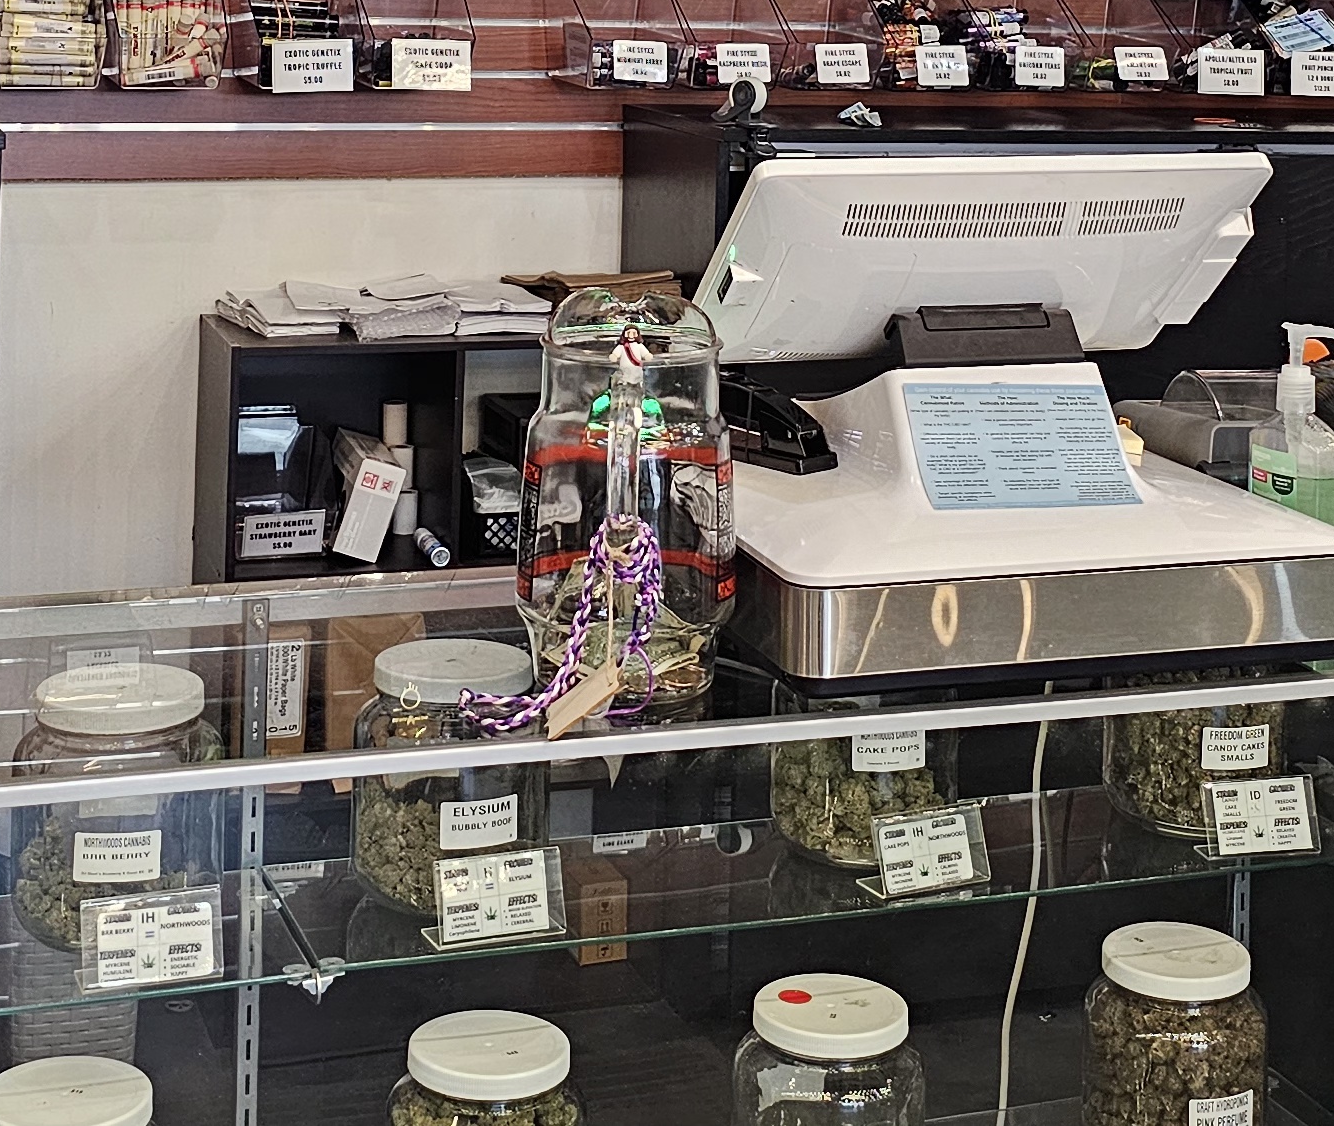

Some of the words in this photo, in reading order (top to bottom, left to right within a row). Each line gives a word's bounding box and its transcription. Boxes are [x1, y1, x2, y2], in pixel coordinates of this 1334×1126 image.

[284, 49, 310, 59] EXOTIC
[311, 48, 342, 58] GENETIX
[283, 62, 310, 72] TROPIC
[311, 61, 343, 71] TRUFFLE
[255, 520, 281, 529] EXOTIC
[282, 519, 313, 527] GENETIX
[249, 530, 297, 540] STRAWBERRY
[1209, 729, 1243, 741] FREEDOM
[1245, 727, 1265, 738] GREEN
[856, 745, 888, 754] CAKE
[891, 743, 921, 753] POPS
[1206, 743, 1238, 752] CANDY
[1240, 741, 1265, 751] CAKES
[1220, 753, 1255, 762] SMALLS
[452, 800, 512, 818] ELYSIUM
[451, 821, 488, 832] BUBBLY
[490, 816, 513, 827] BOOF
[83, 836, 123, 849] NORTHWOODS
[123, 835, 152, 848] CANNABIS
[111, 851, 152, 861] BERRY
[159, 919, 212, 931] NORTHWOODS
[1196, 1100, 1214, 1114] CRAFT
